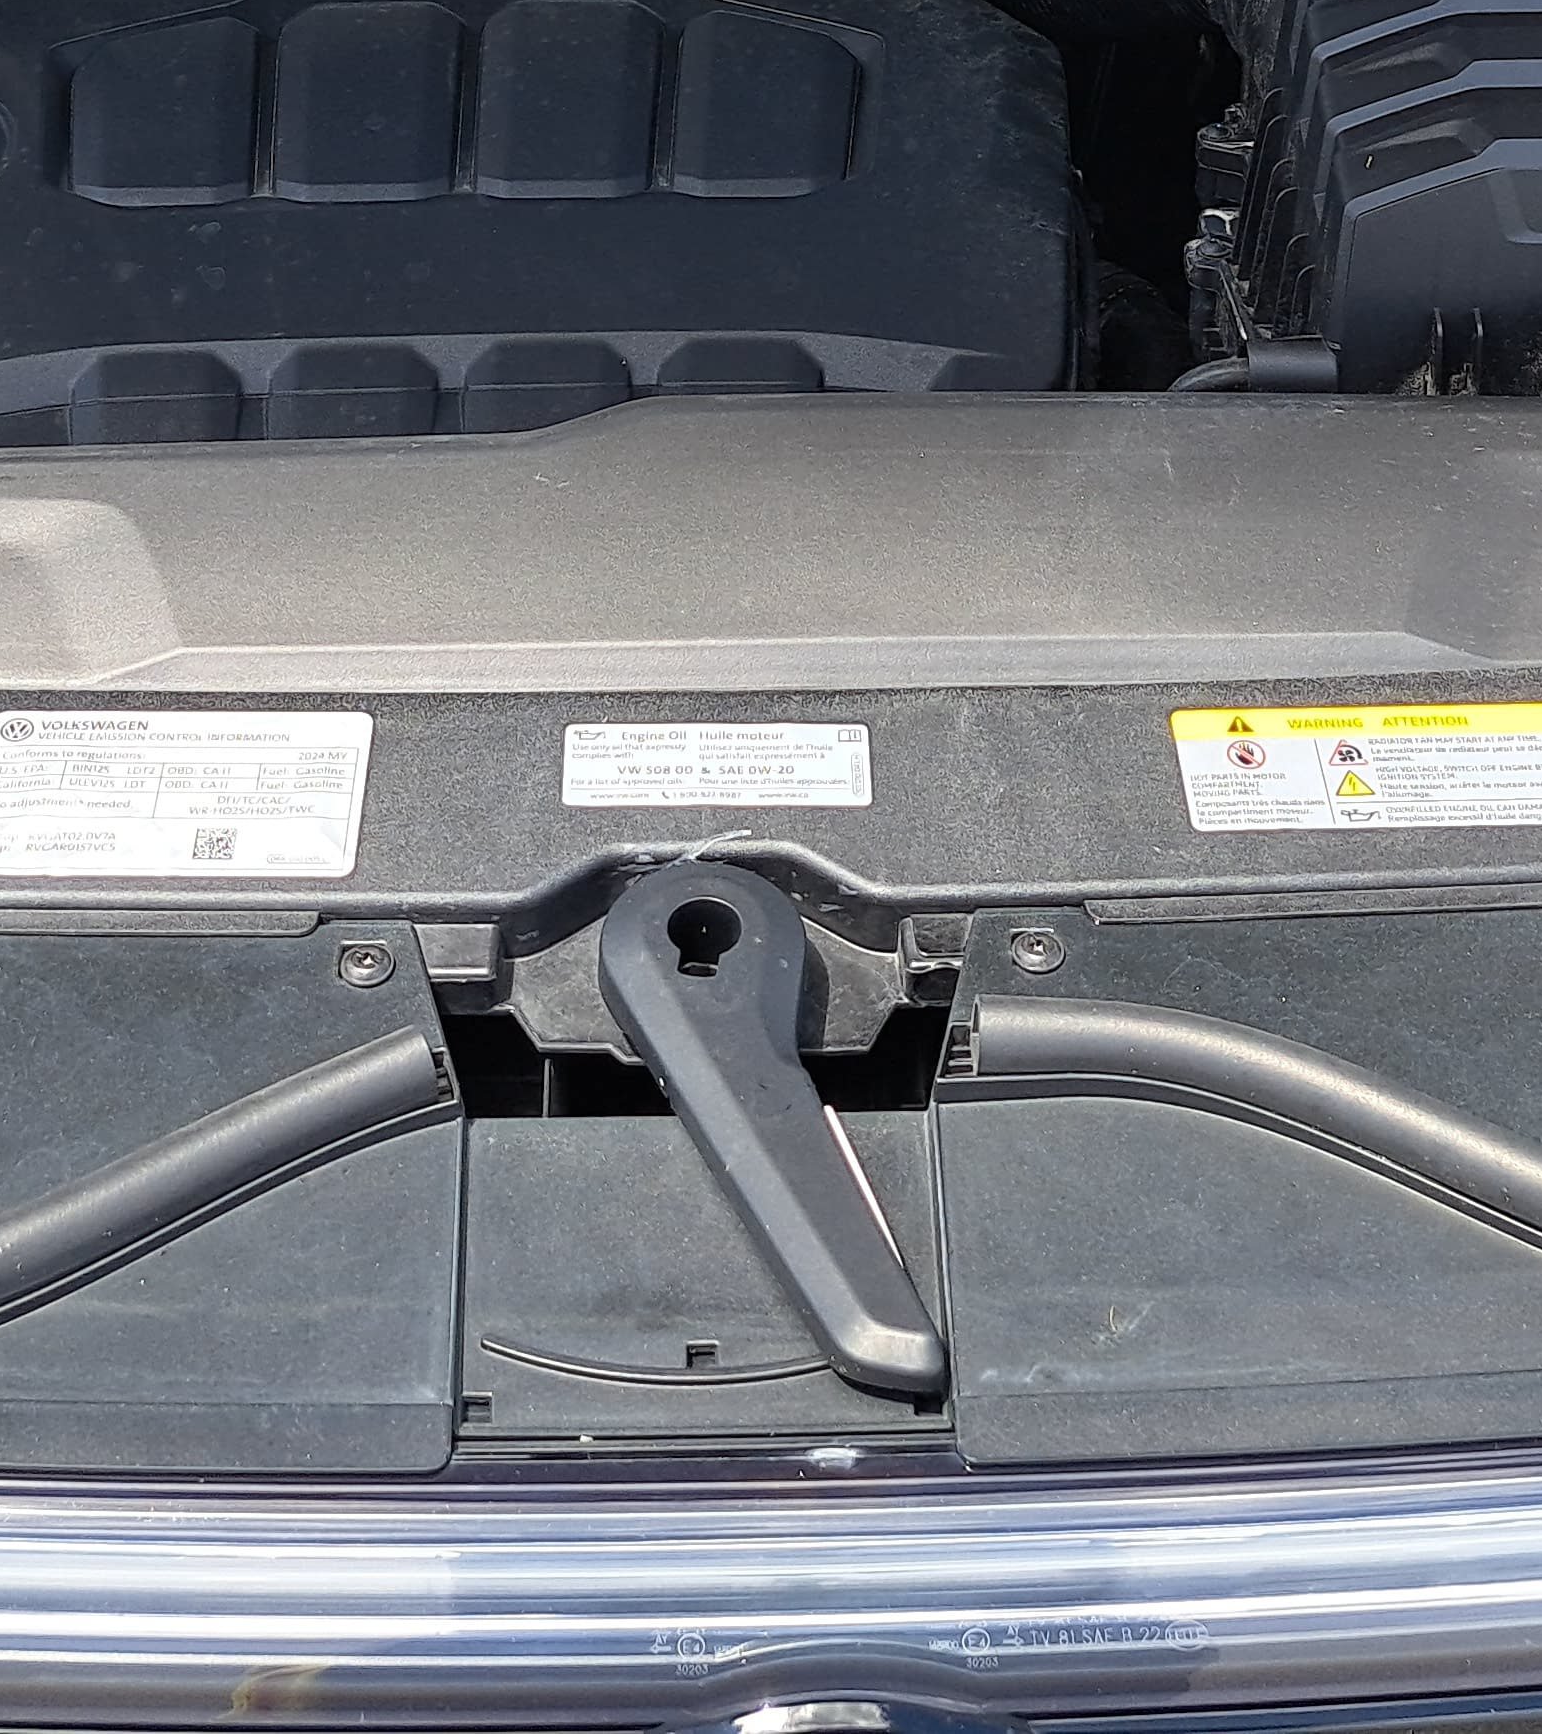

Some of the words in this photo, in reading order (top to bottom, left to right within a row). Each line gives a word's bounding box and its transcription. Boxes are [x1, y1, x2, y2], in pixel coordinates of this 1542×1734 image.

[41, 720, 149, 731] VOLKSWAGEN
[1287, 717, 1364, 729] WARNING
[1382, 716, 1469, 727] ATTENTION
[38, 732, 86, 741] VEHICLE
[89, 732, 146, 742] EMISSION
[149, 733, 202, 742] CONTROL
[207, 733, 291, 742] INFORMATION
[621, 731, 665, 743] Engine
[668, 730, 687, 741] Oil
[699, 731, 733, 740] Huile
[736, 731, 784, 741] moteur
[2, 749, 59, 760] Conforms
[62, 750, 75, 759] to
[295, 767, 346, 776] Gasoline
[617, 765, 642, 775] VW
[645, 765, 671, 775] 508
[674, 765, 694, 775] 00
[719, 765, 744, 775] SAE
[1211, 773, 1239, 781] PARTS
[1240, 772, 1252, 780] IN
[1252, 772, 1287, 781] MOTOR
[293, 780, 344, 789] Gasoline
[1193, 789, 1231, 798] MOVING
